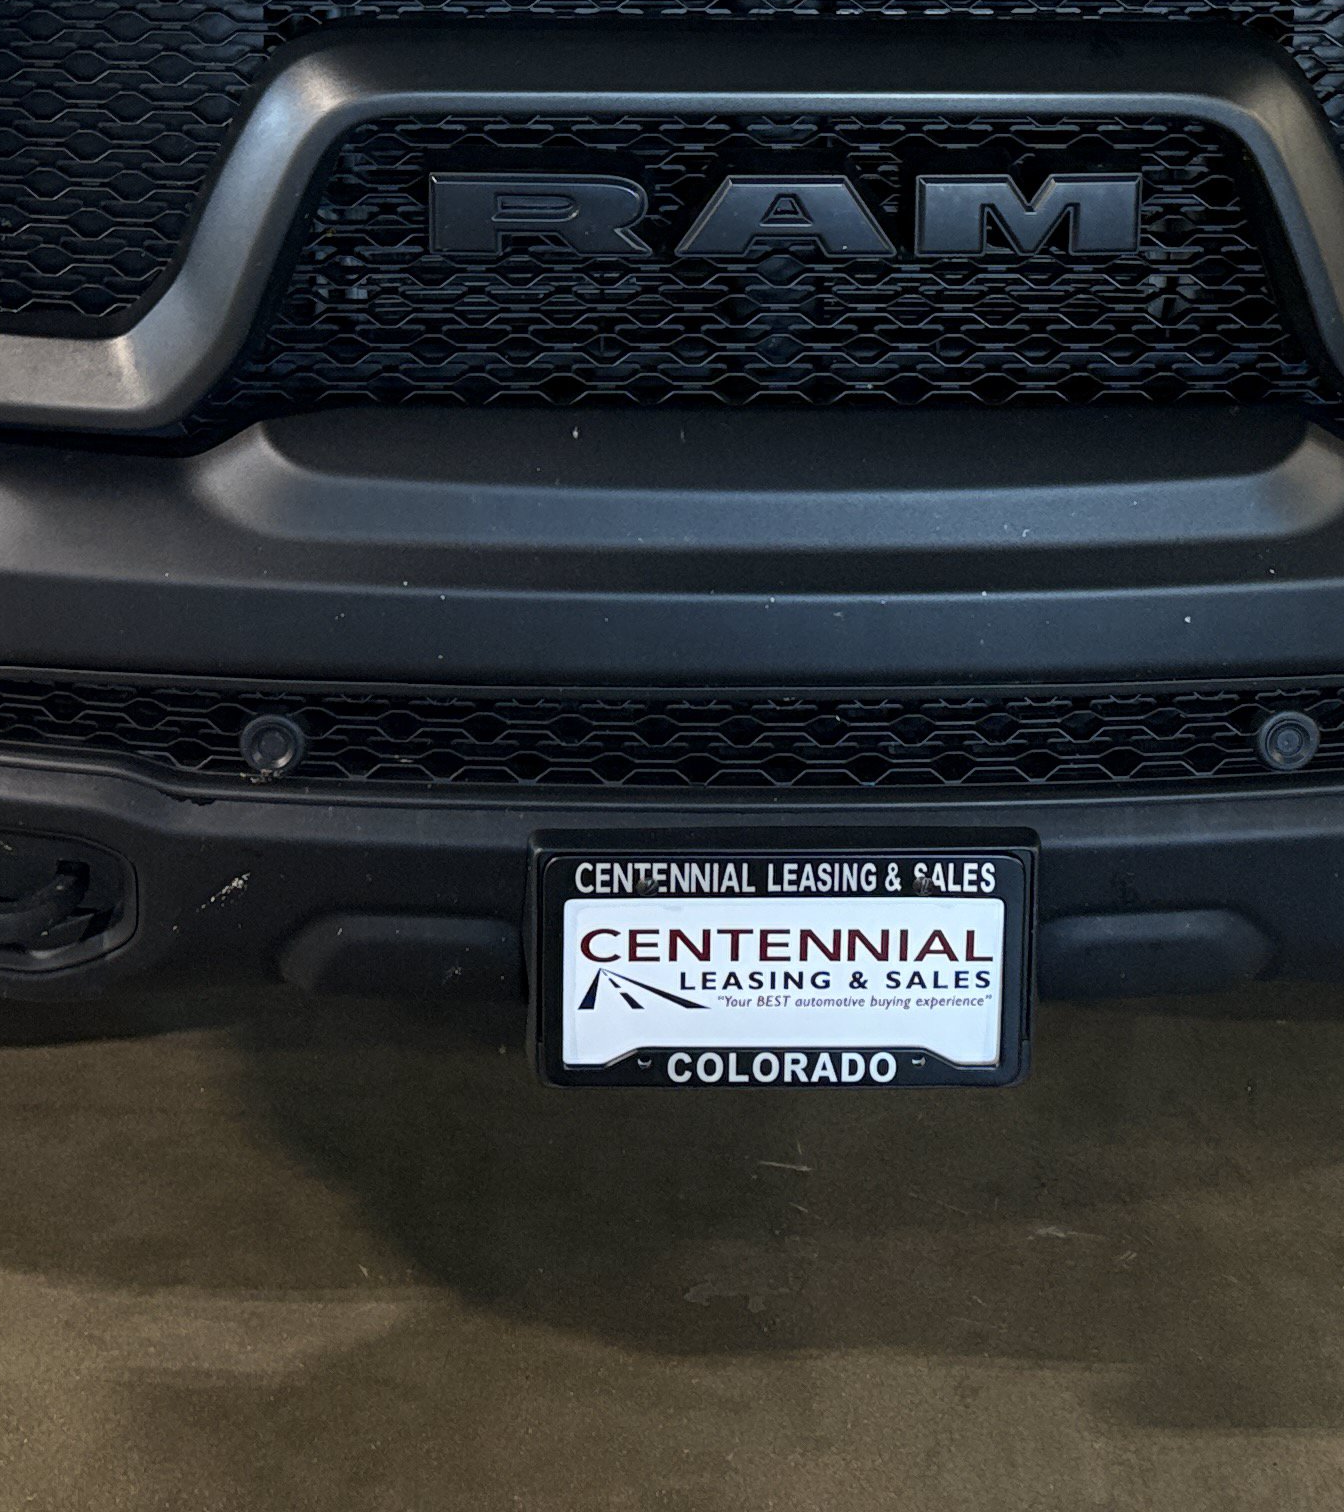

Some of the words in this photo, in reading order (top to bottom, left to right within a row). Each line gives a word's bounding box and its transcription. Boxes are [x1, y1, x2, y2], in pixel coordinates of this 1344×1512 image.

[428, 172, 1143, 258] RAM
[574, 862, 756, 894] CENTENNIAL
[767, 862, 877, 892] LEASING
[884, 862, 902, 892] &
[913, 862, 996, 893] SALES
[580, 928, 994, 963] CENTENNIAL
[680, 970, 831, 990] LEASING
[848, 970, 868, 990] &
[885, 970, 991, 990] SALES
[757, 995, 791, 1008] BEST
[794, 995, 865, 1008] automotive
[869, 995, 911, 1010] buying
[667, 1051, 898, 1084] COLORADO
